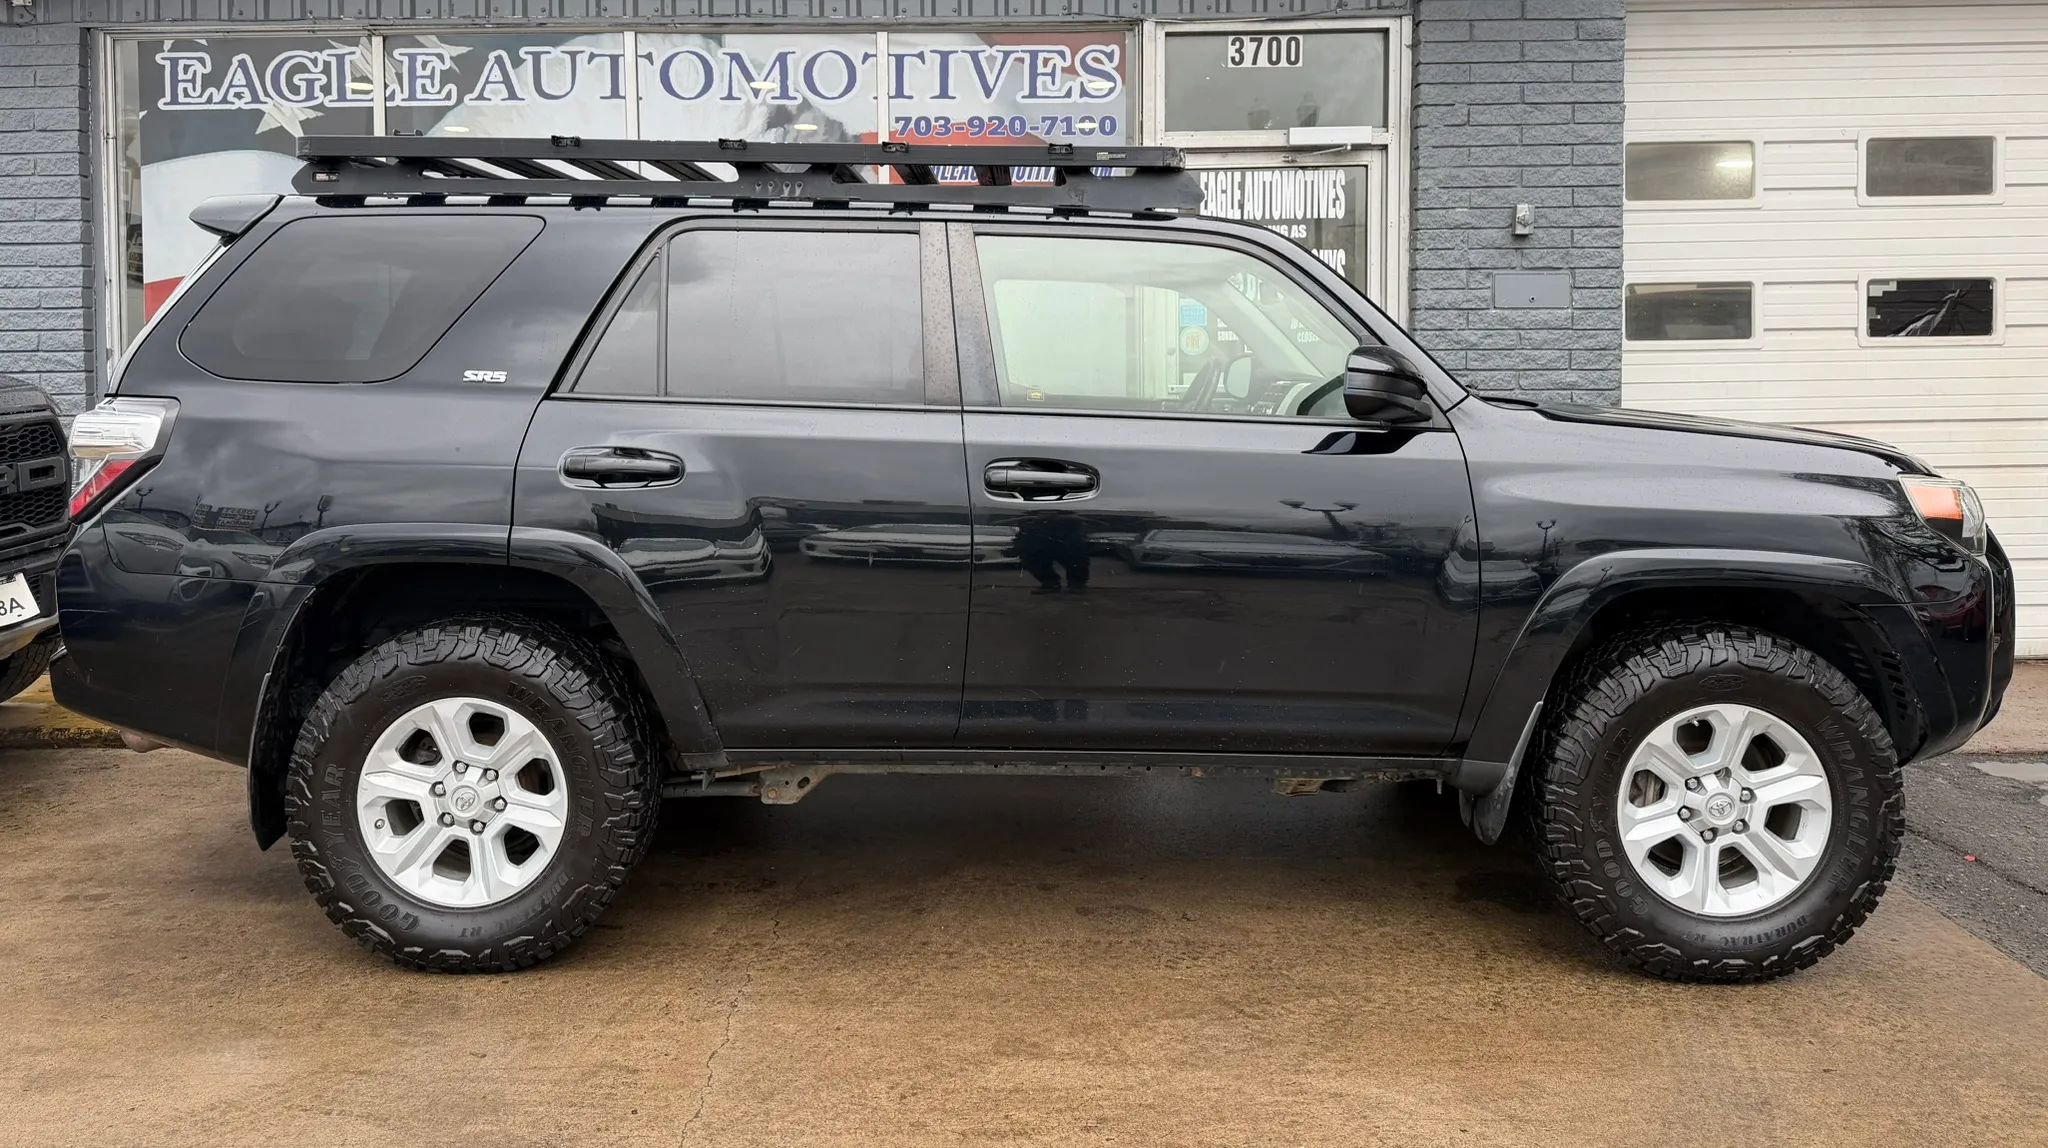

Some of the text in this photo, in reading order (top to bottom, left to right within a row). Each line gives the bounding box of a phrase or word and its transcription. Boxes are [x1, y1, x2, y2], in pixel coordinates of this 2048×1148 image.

[1230, 36, 1301, 66] 3700
[156, 44, 1122, 110] EAGLE AUTOMOTIVES
[894, 114, 1119, 138] 703-920-7100
[1200, 168, 1346, 221] EAGLE AUTOMOTIVES
[1290, 224, 1307, 239] AS
[463, 369, 508, 382] SR5
[1589, 727, 1649, 916] GOODYAR
